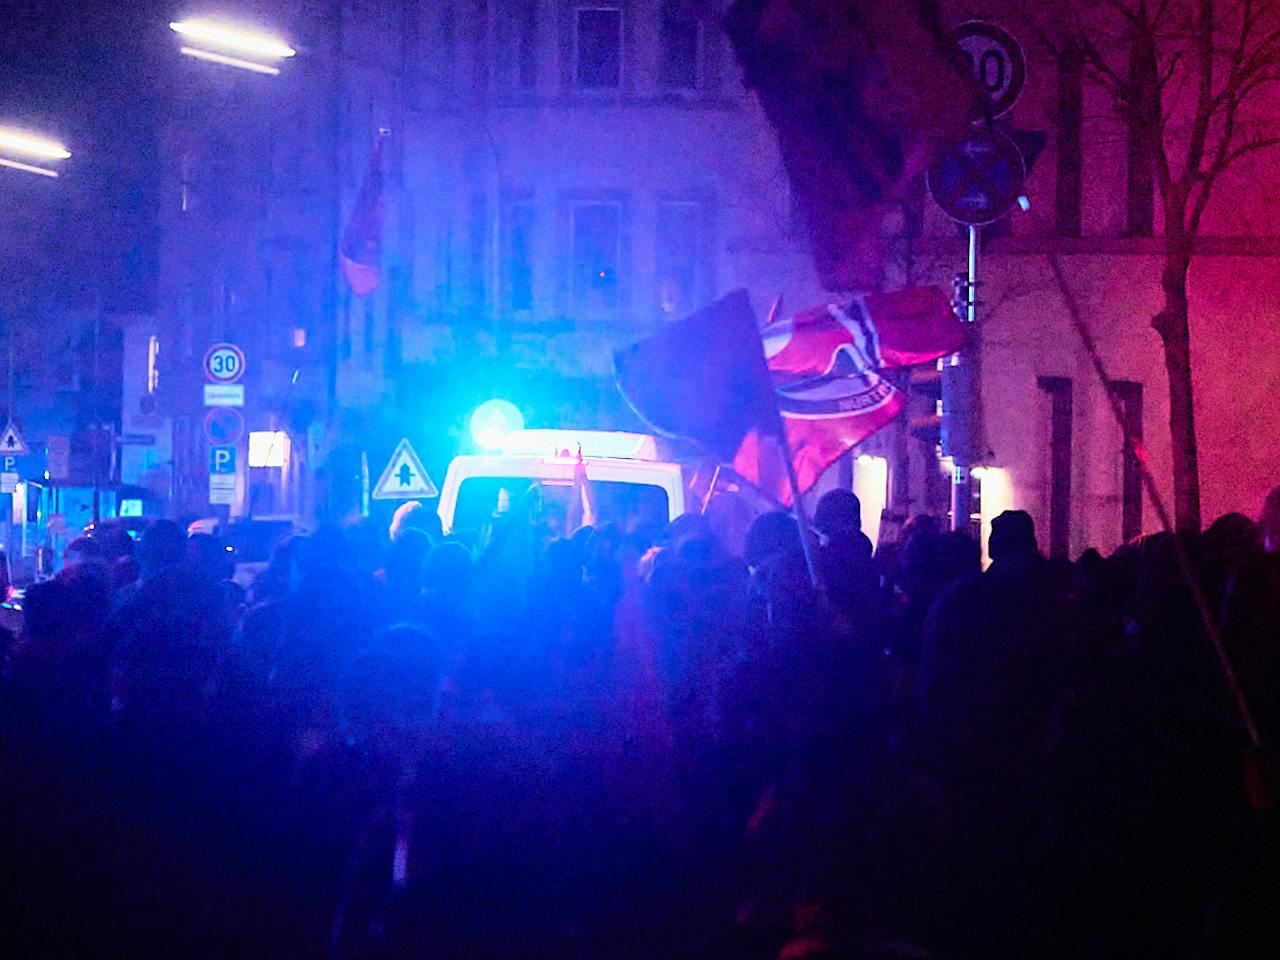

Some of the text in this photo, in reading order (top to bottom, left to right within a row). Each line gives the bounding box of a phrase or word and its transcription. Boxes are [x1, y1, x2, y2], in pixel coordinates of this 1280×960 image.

[213, 355, 236, 373] 30
[4, 456, 15, 471] P
[215, 450, 231, 471] P
